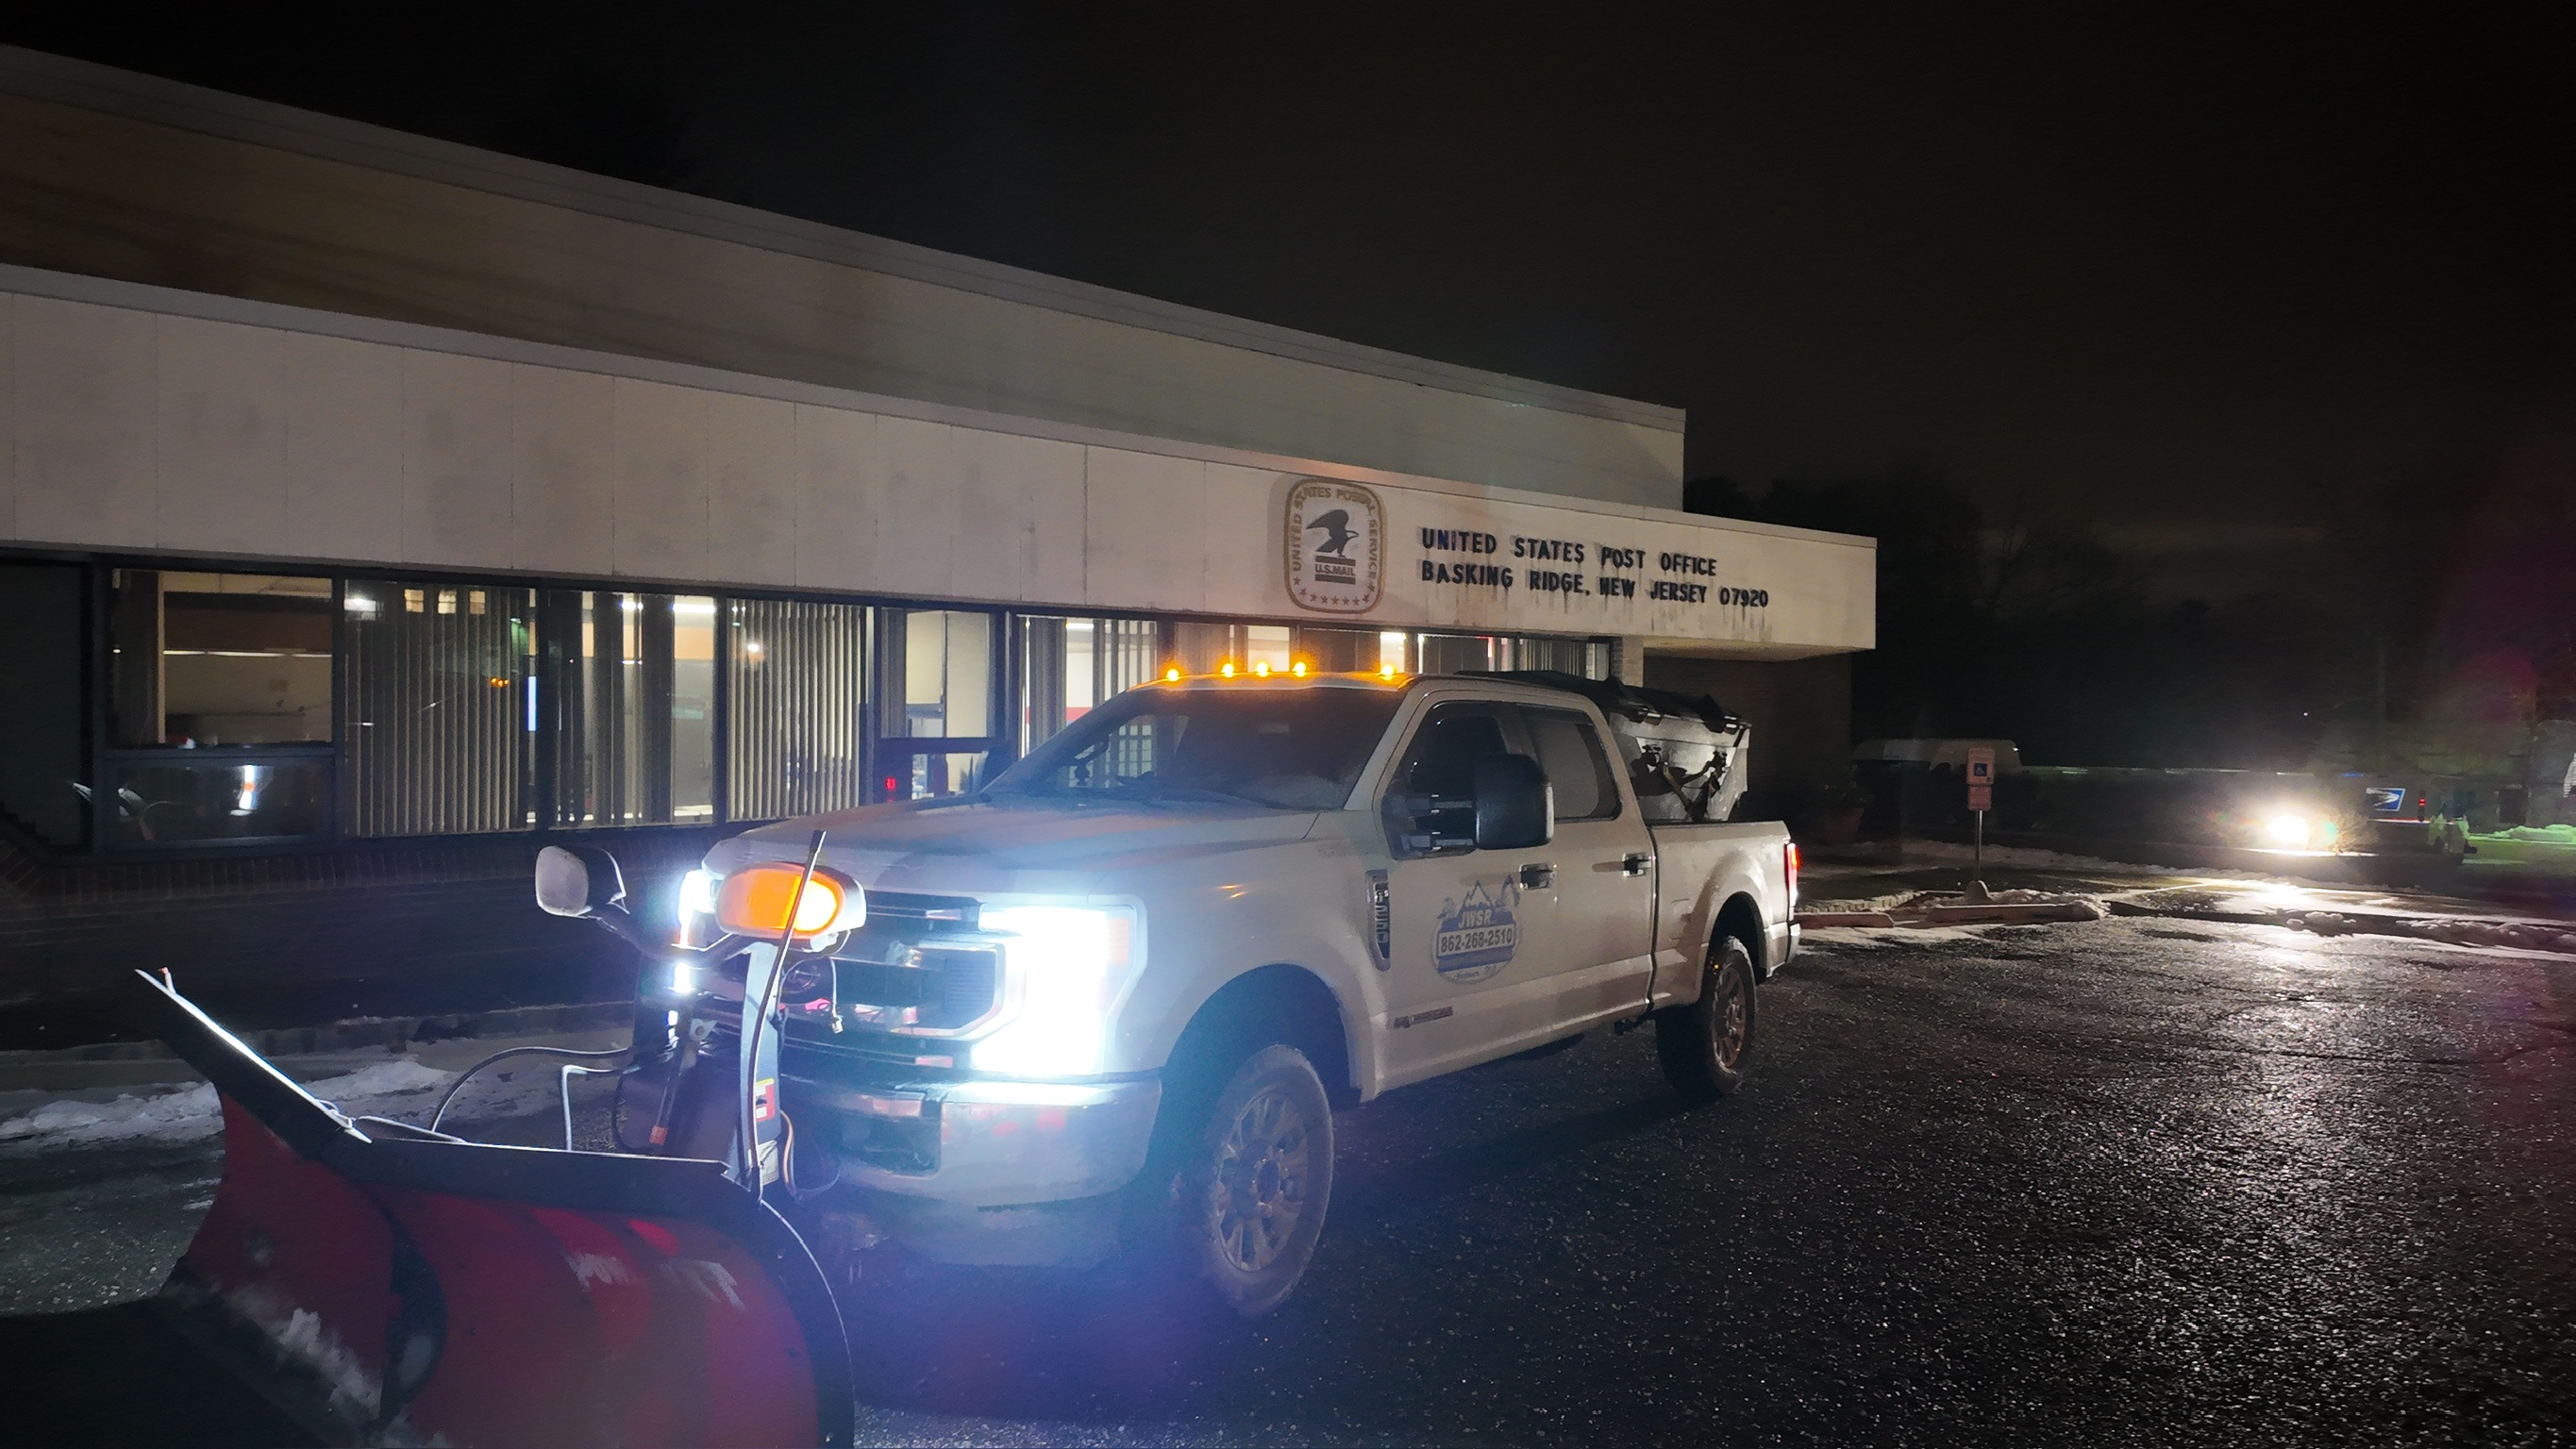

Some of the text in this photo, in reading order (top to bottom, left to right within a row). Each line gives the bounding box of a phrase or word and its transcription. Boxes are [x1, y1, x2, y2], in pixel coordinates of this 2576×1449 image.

[1292, 514, 1302, 572] UNITED
[1368, 519, 1379, 580] SERVICE
[1420, 526, 1718, 577] UNITED STATES POST OFFICE
[1420, 559, 1514, 589] BASKING
[1598, 576, 1636, 600] NEW
[1649, 580, 1708, 604] JERSEY
[1718, 587, 1770, 608] 07920
[1458, 908, 1493, 929] JWSR
